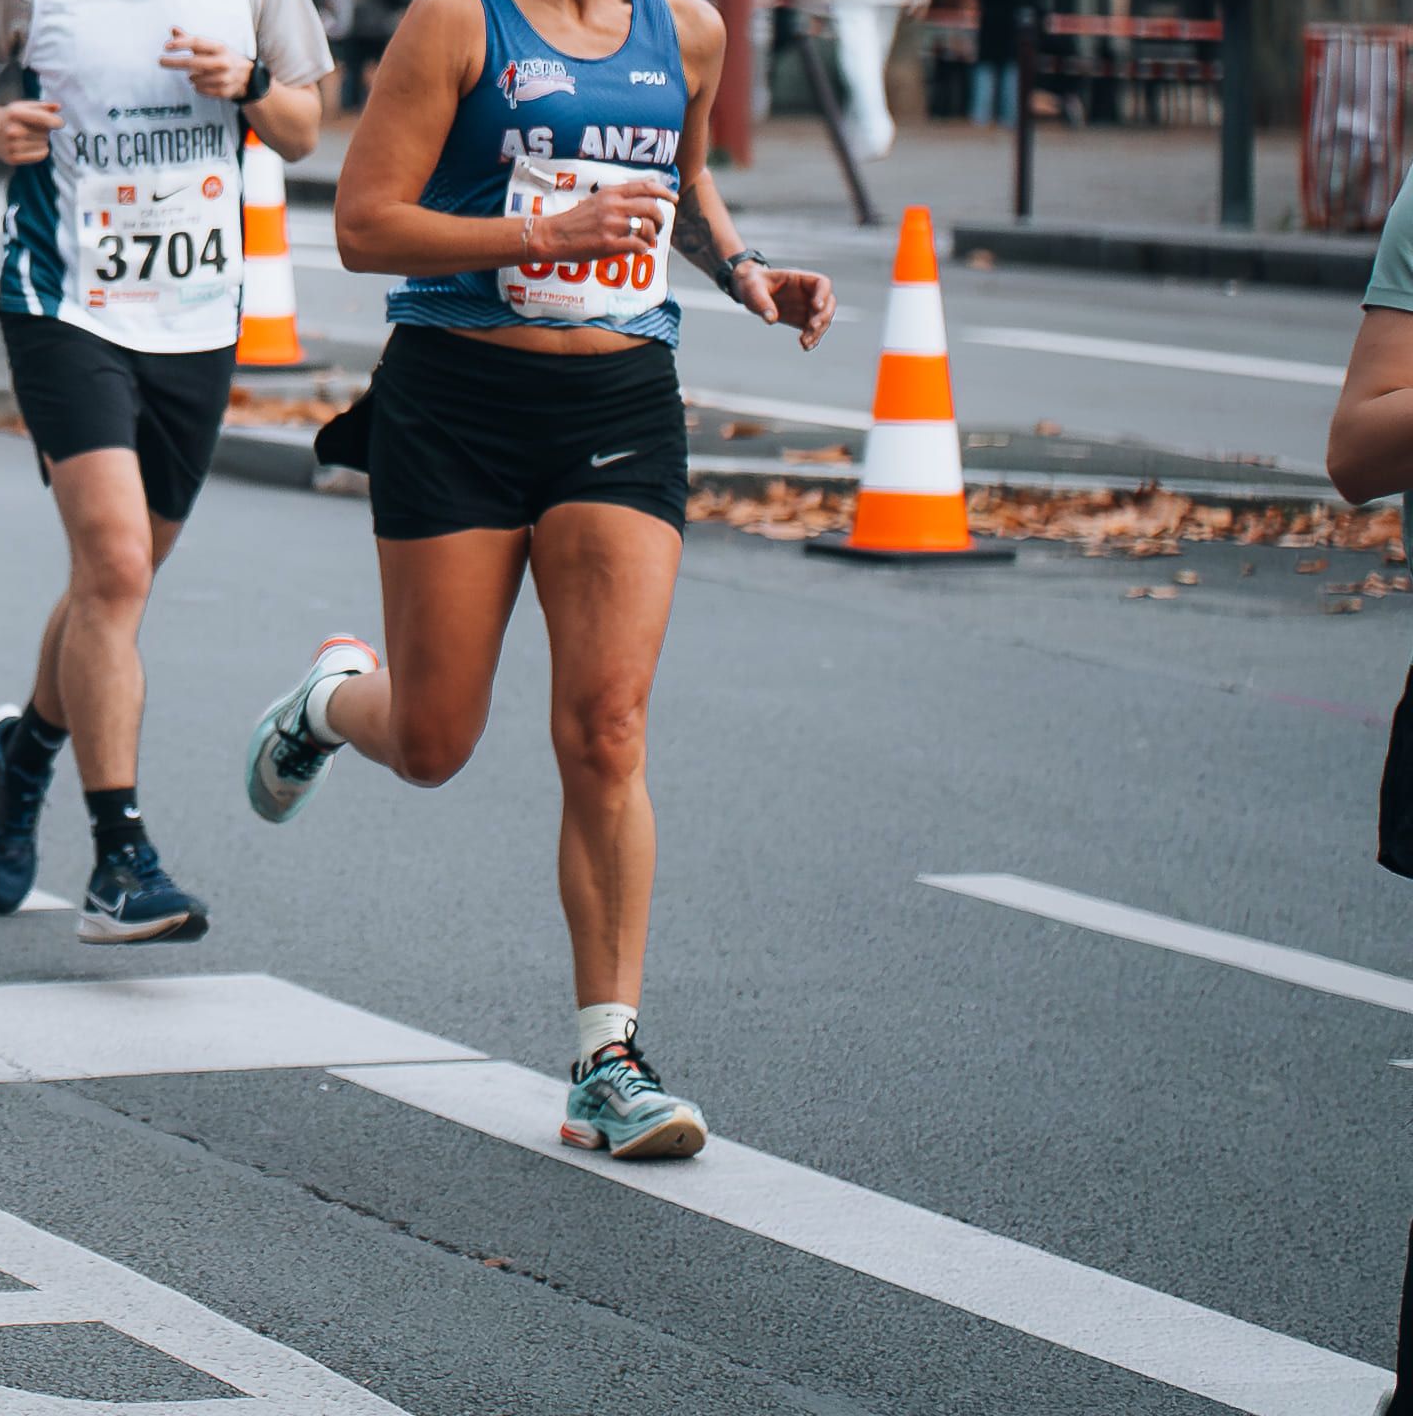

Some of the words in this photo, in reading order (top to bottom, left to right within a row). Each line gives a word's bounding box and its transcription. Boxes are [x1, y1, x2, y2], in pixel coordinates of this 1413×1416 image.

[501, 127, 554, 160] AS
[579, 125, 681, 165] ANZIN
[96, 228, 228, 282] 3704
